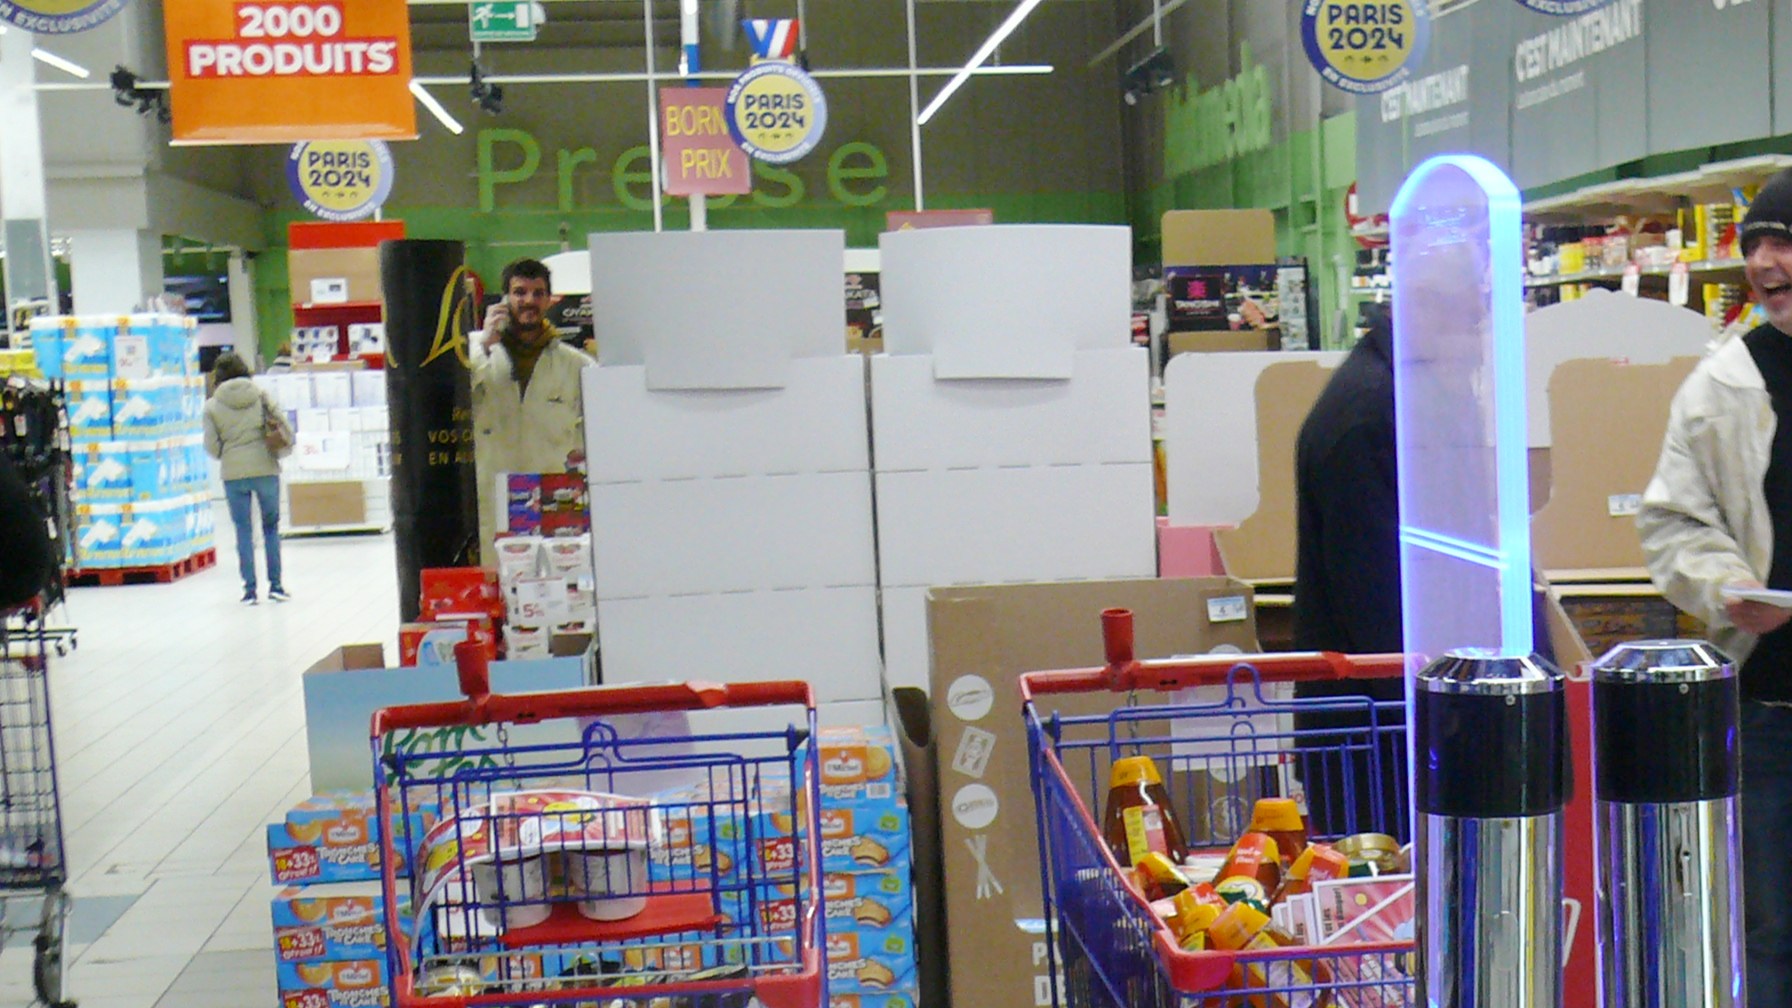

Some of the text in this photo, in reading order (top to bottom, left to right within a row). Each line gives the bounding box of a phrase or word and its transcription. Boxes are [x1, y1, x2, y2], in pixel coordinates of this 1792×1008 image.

[238, 5, 342, 38] 2000
[1328, 4, 1404, 26] PARIS
[1328, 28, 1404, 50] 2024
[189, 41, 396, 77] PRODUITS
[744, 94, 805, 111] PARIS
[665, 105, 731, 136] BORN
[744, 112, 805, 129] 2024
[308, 151, 371, 169] PARIS
[478, 129, 889, 213] Prese
[680, 148, 733, 179] PRIX
[308, 170, 371, 188] 2024
[428, 431, 458, 444] VOS
